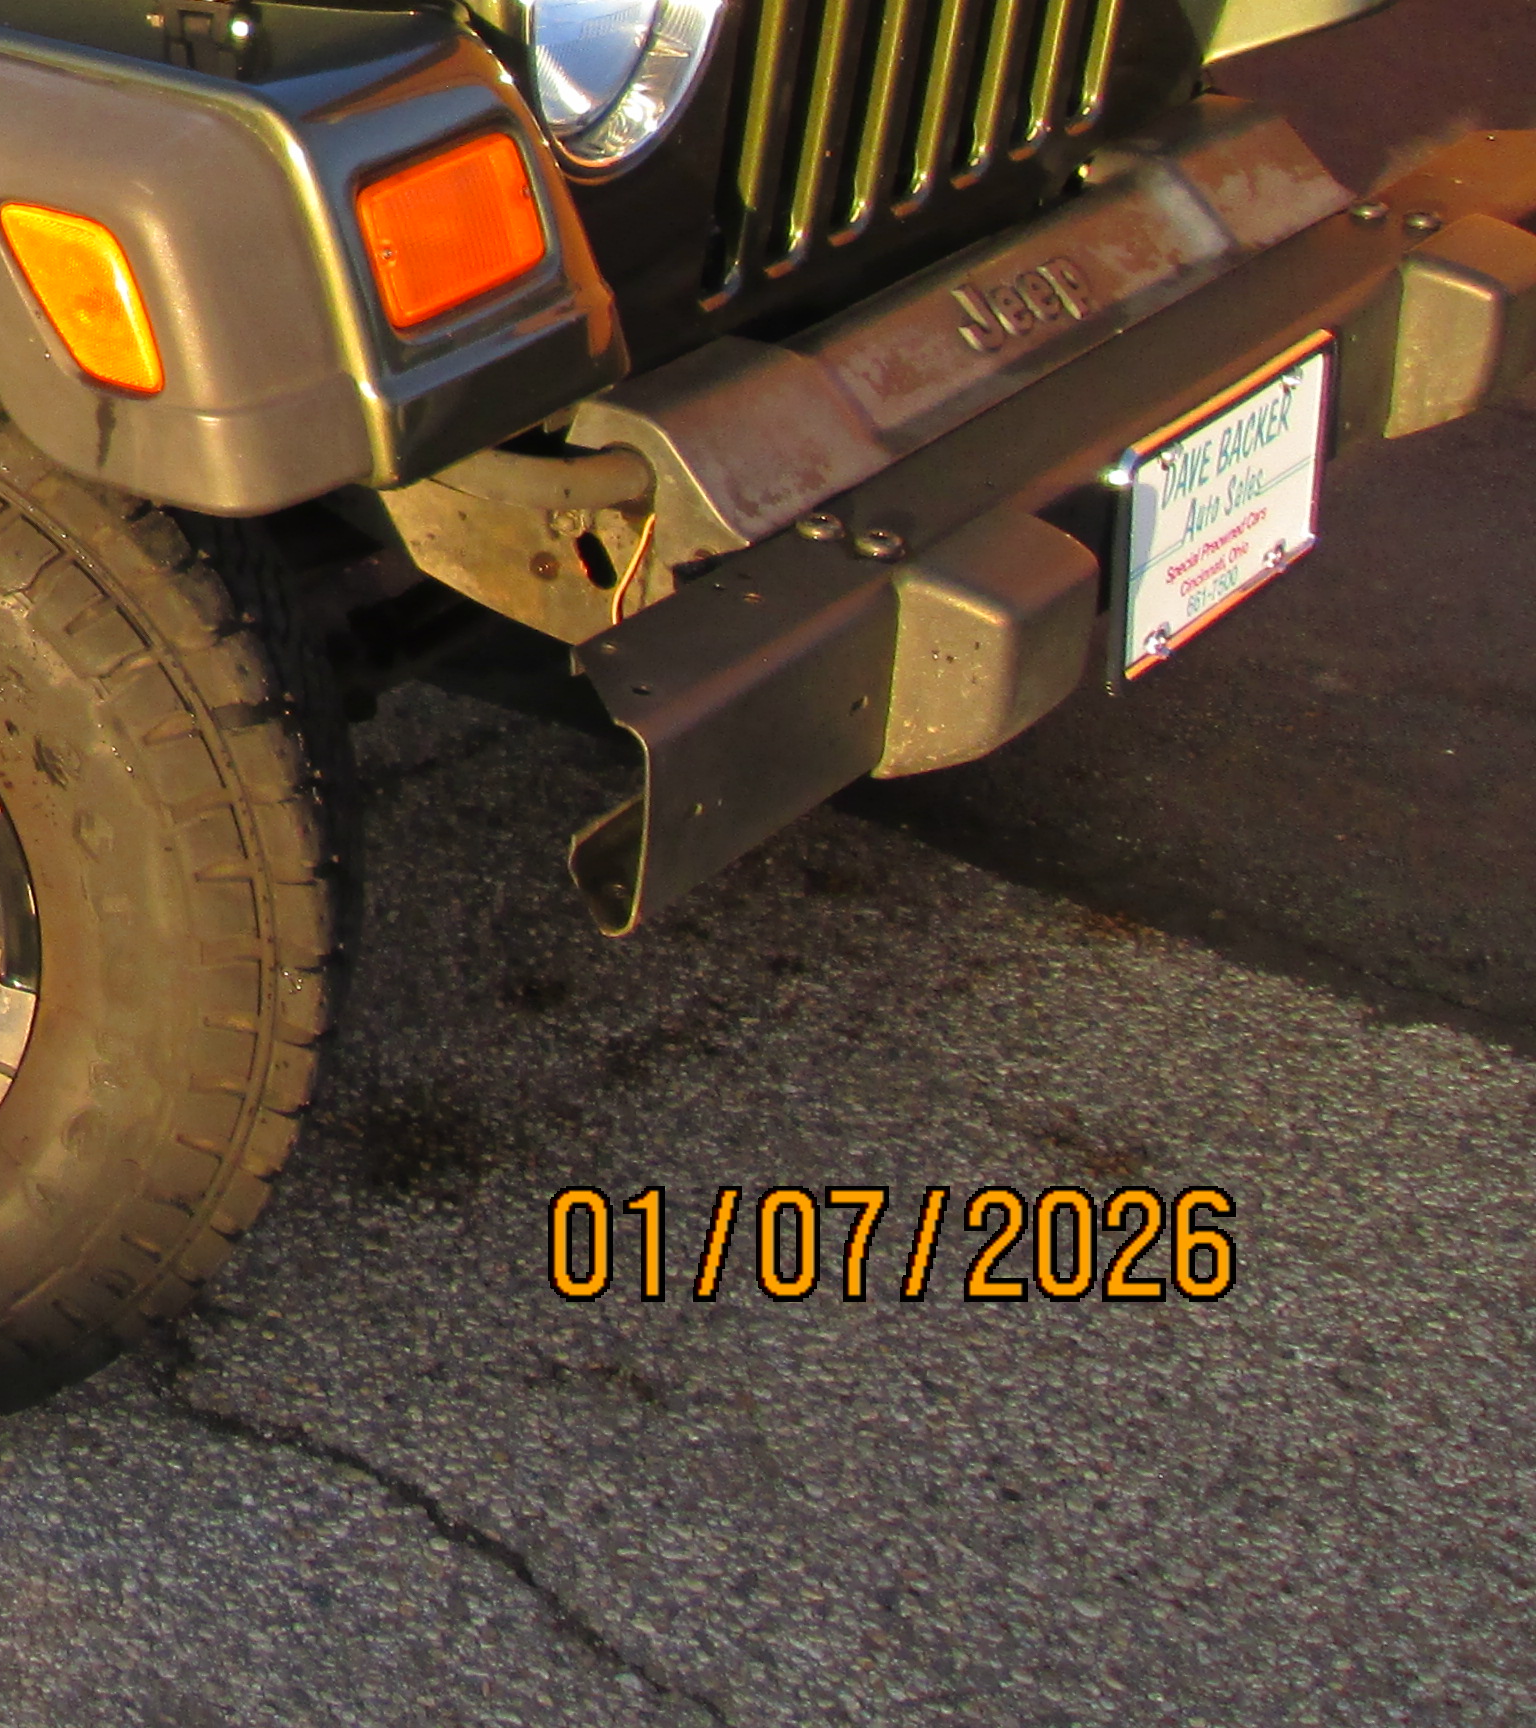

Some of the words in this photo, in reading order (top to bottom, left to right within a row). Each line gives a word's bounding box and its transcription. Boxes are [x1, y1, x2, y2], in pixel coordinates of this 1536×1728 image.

[949, 256, 1091, 351] Jeep
[1162, 440, 1212, 510] DAVE
[1216, 391, 1292, 475] BACKER
[1181, 496, 1221, 546] Auto
[1223, 465, 1264, 517] Sales
